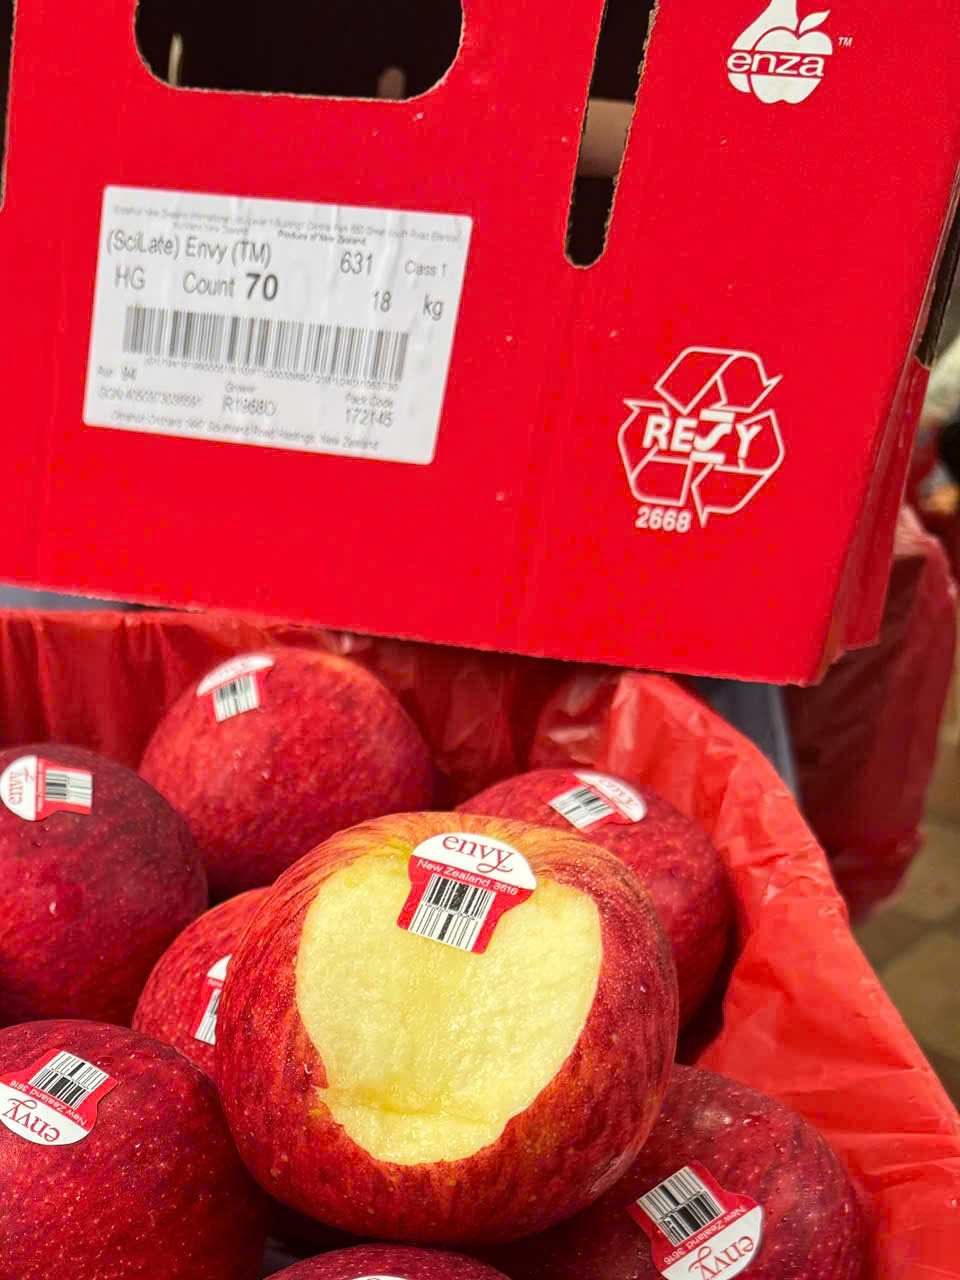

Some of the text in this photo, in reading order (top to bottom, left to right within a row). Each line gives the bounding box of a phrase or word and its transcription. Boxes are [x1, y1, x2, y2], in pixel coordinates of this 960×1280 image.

[727, 52, 824, 77] enza
[106, 229, 272, 269] (SciLate) Envy (TM)
[340, 251, 373, 275] 631
[114, 264, 146, 290] HG
[404, 259, 437, 277] Class
[183, 271, 279, 301] Count 70
[373, 290, 444, 321] 18 kg
[635, 505, 692, 534] 2668
[442, 835, 515, 874] envy
[417, 858, 444, 873] New
[444, 864, 492, 888] Zealand
[28, 1088, 67, 1112] Zealand
[1, 1097, 60, 1143] envy
[65, 1108, 88, 1127] New
[663, 1206, 746, 1265] New Zealand 3616
